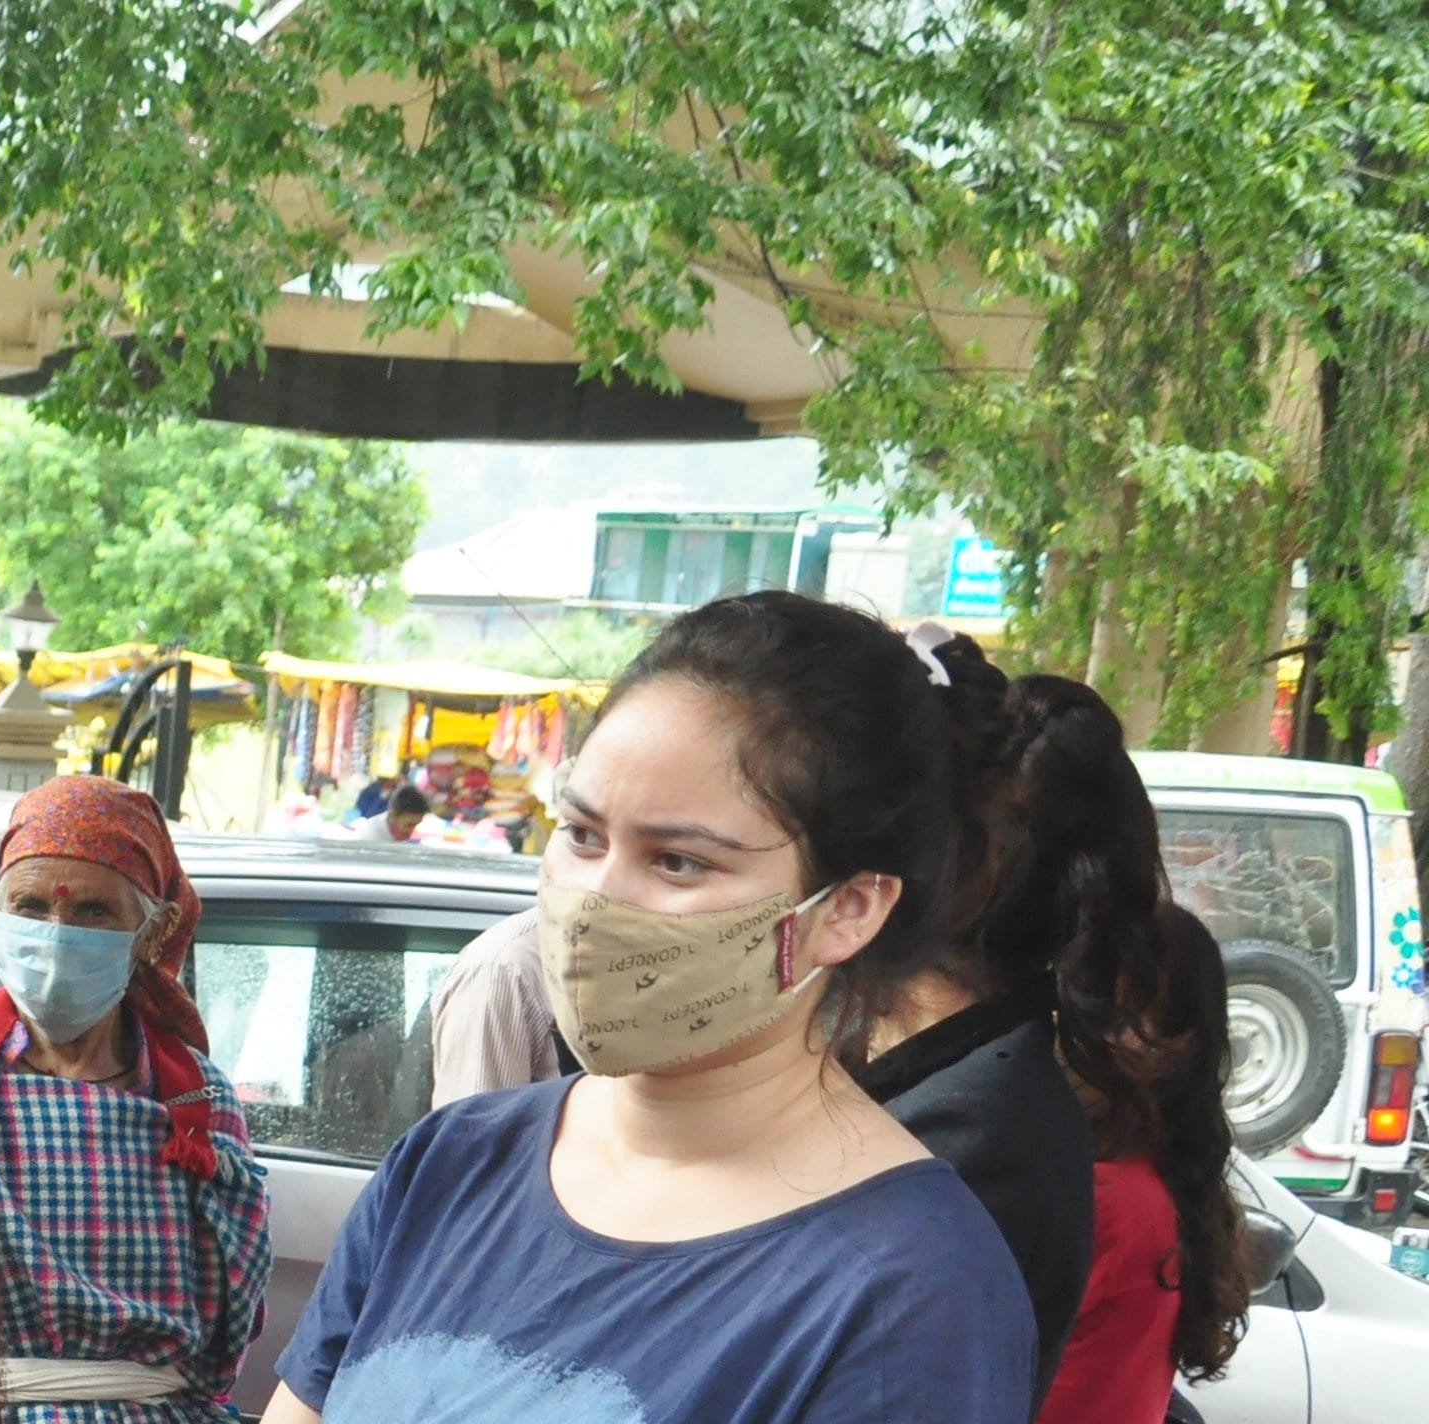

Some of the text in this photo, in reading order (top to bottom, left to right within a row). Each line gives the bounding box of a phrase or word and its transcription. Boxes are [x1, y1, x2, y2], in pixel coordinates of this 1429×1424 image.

[717, 902, 781, 944] CONCEPT
[606, 945, 682, 973] CONCEPT
[661, 985, 738, 1022] CONCEPT
